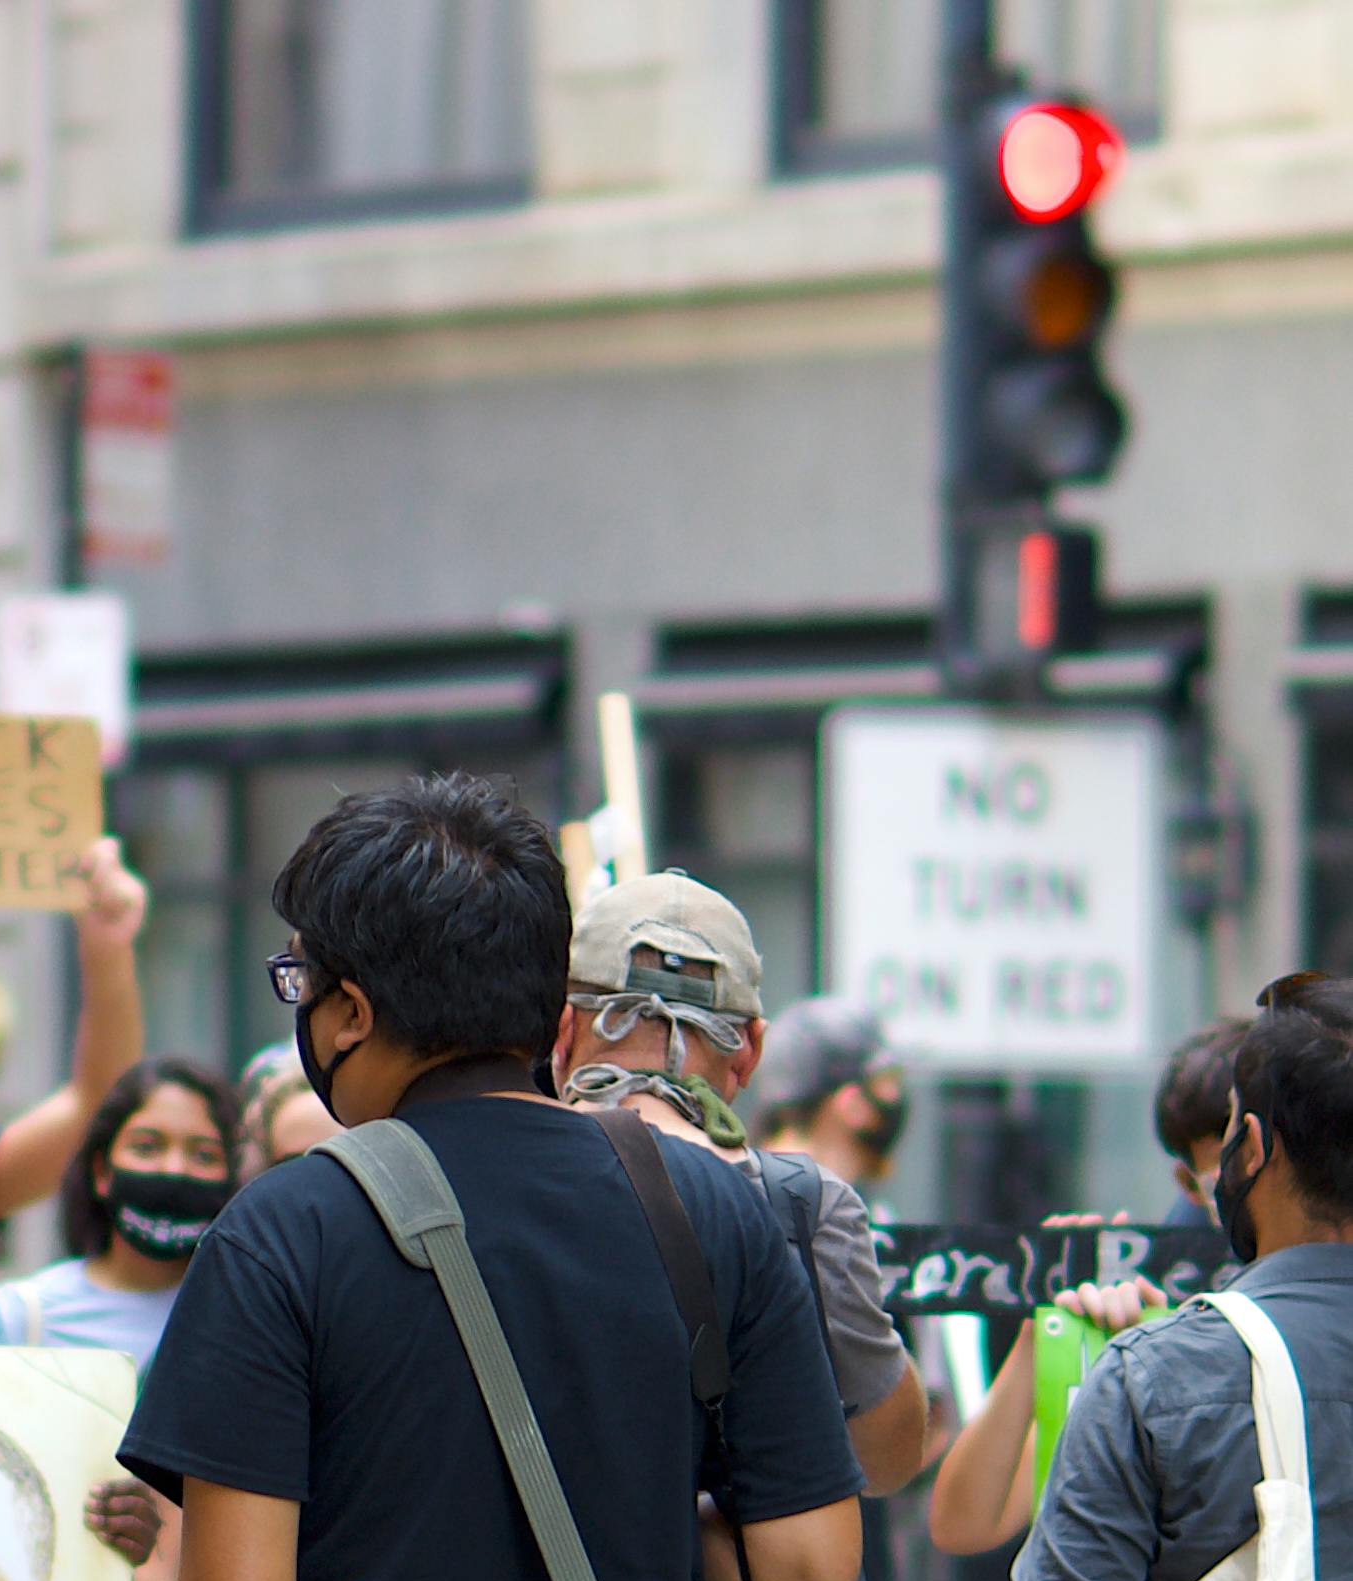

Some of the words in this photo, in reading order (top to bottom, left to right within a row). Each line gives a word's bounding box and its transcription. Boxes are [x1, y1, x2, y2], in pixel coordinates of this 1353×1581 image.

[943, 765, 1050, 828] NO
[913, 858, 1090, 924] TURN
[867, 955, 959, 1018] ON
[997, 957, 1125, 1021] RED
